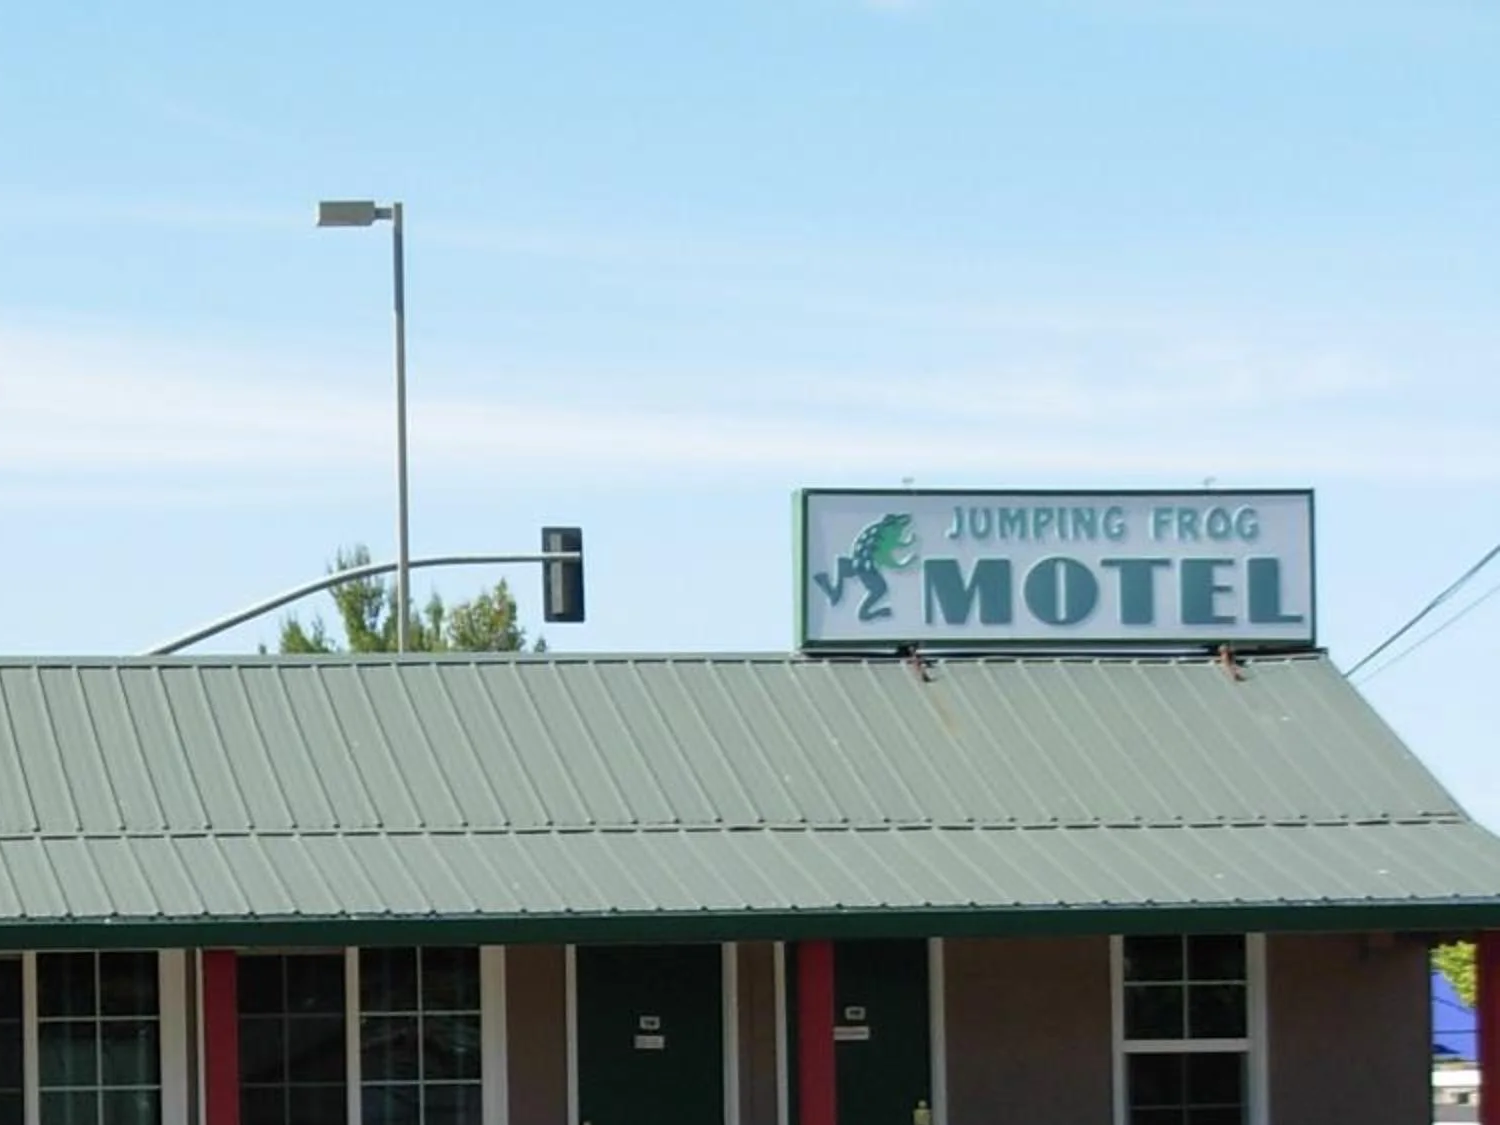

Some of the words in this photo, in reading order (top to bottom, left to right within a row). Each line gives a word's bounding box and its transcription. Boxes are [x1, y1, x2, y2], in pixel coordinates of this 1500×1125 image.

[946, 505, 1127, 541] JUMPING
[1151, 505, 1260, 542] FROG
[924, 556, 1304, 626] MOTEL
